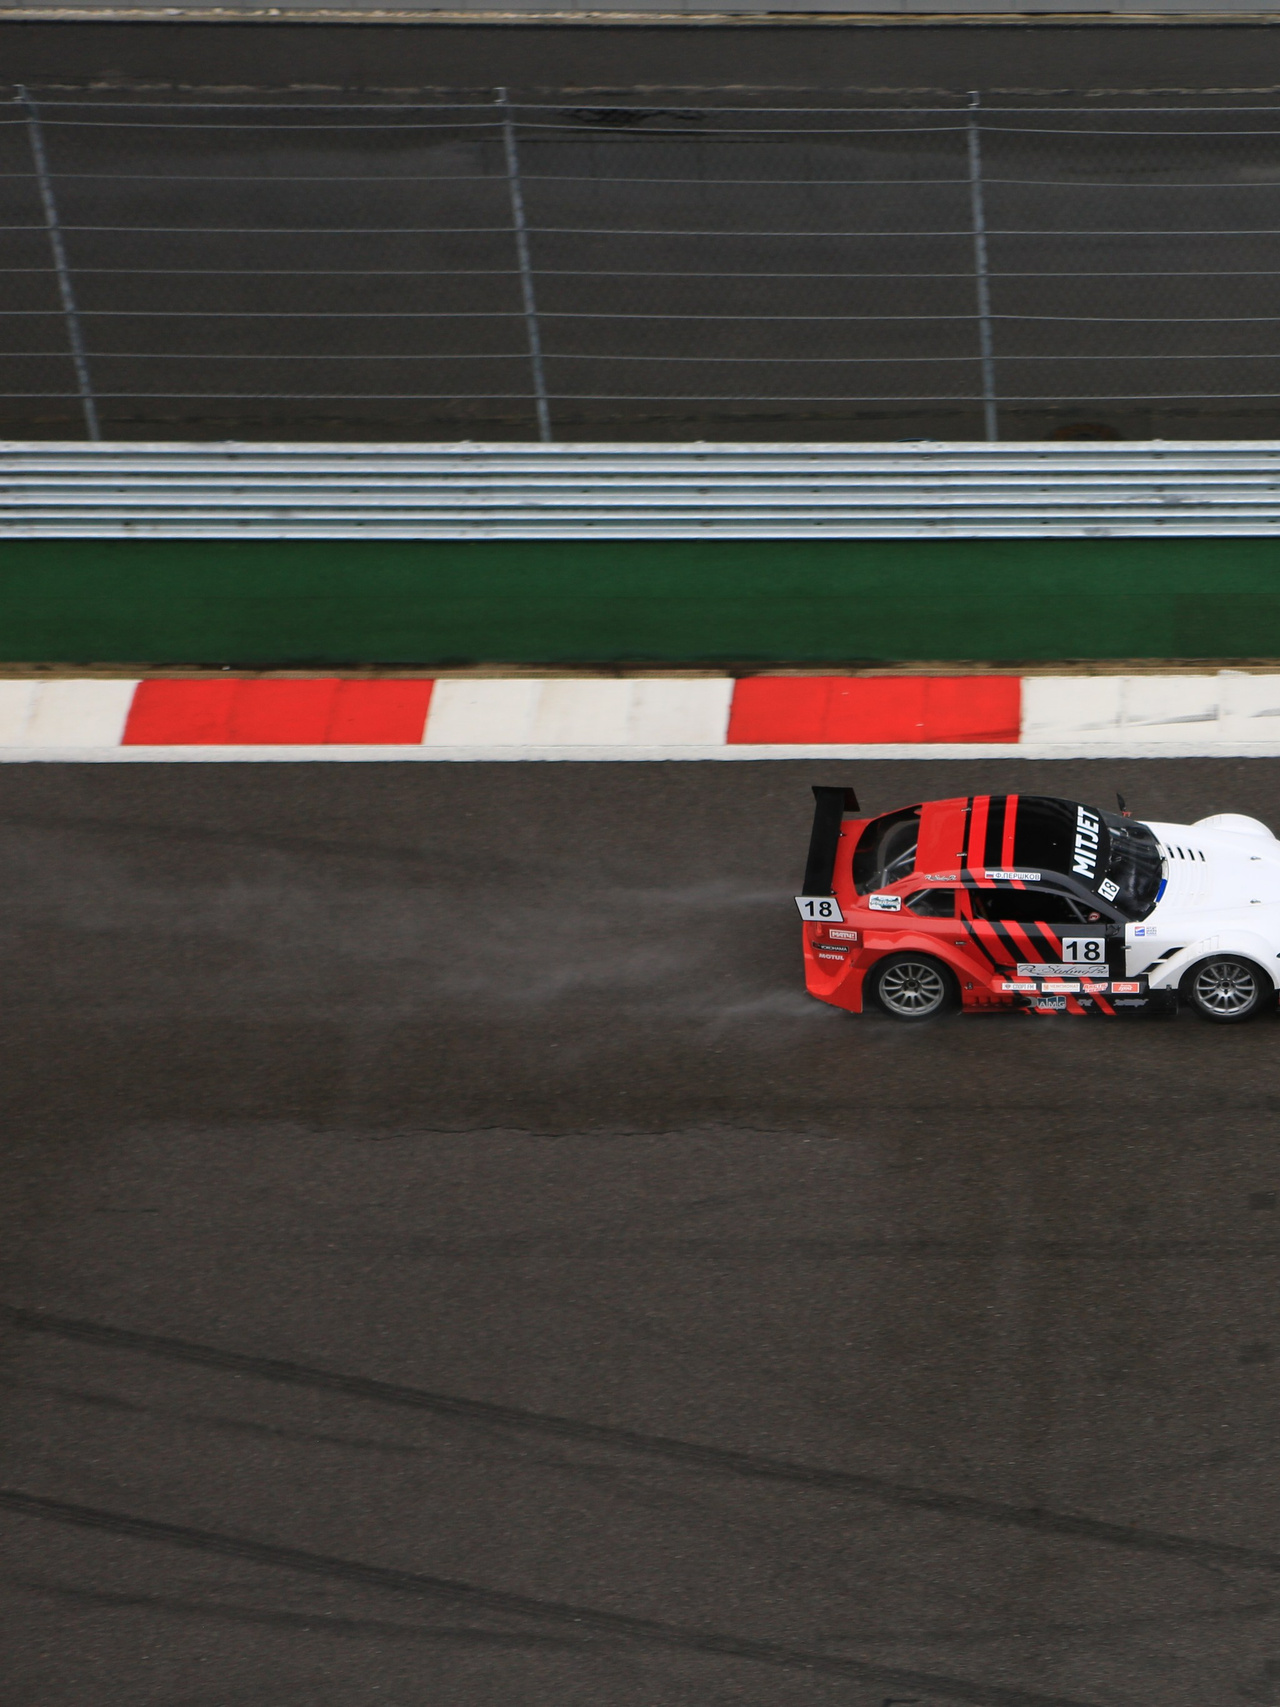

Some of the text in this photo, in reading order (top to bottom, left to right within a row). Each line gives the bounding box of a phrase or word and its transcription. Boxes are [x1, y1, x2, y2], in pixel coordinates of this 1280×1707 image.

[1072, 806, 1099, 879] MITJET
[1102, 881, 1118, 898] 18
[805, 901, 832, 917] 18
[819, 953, 845, 961] MOTUL
[1066, 941, 1101, 961] 18
